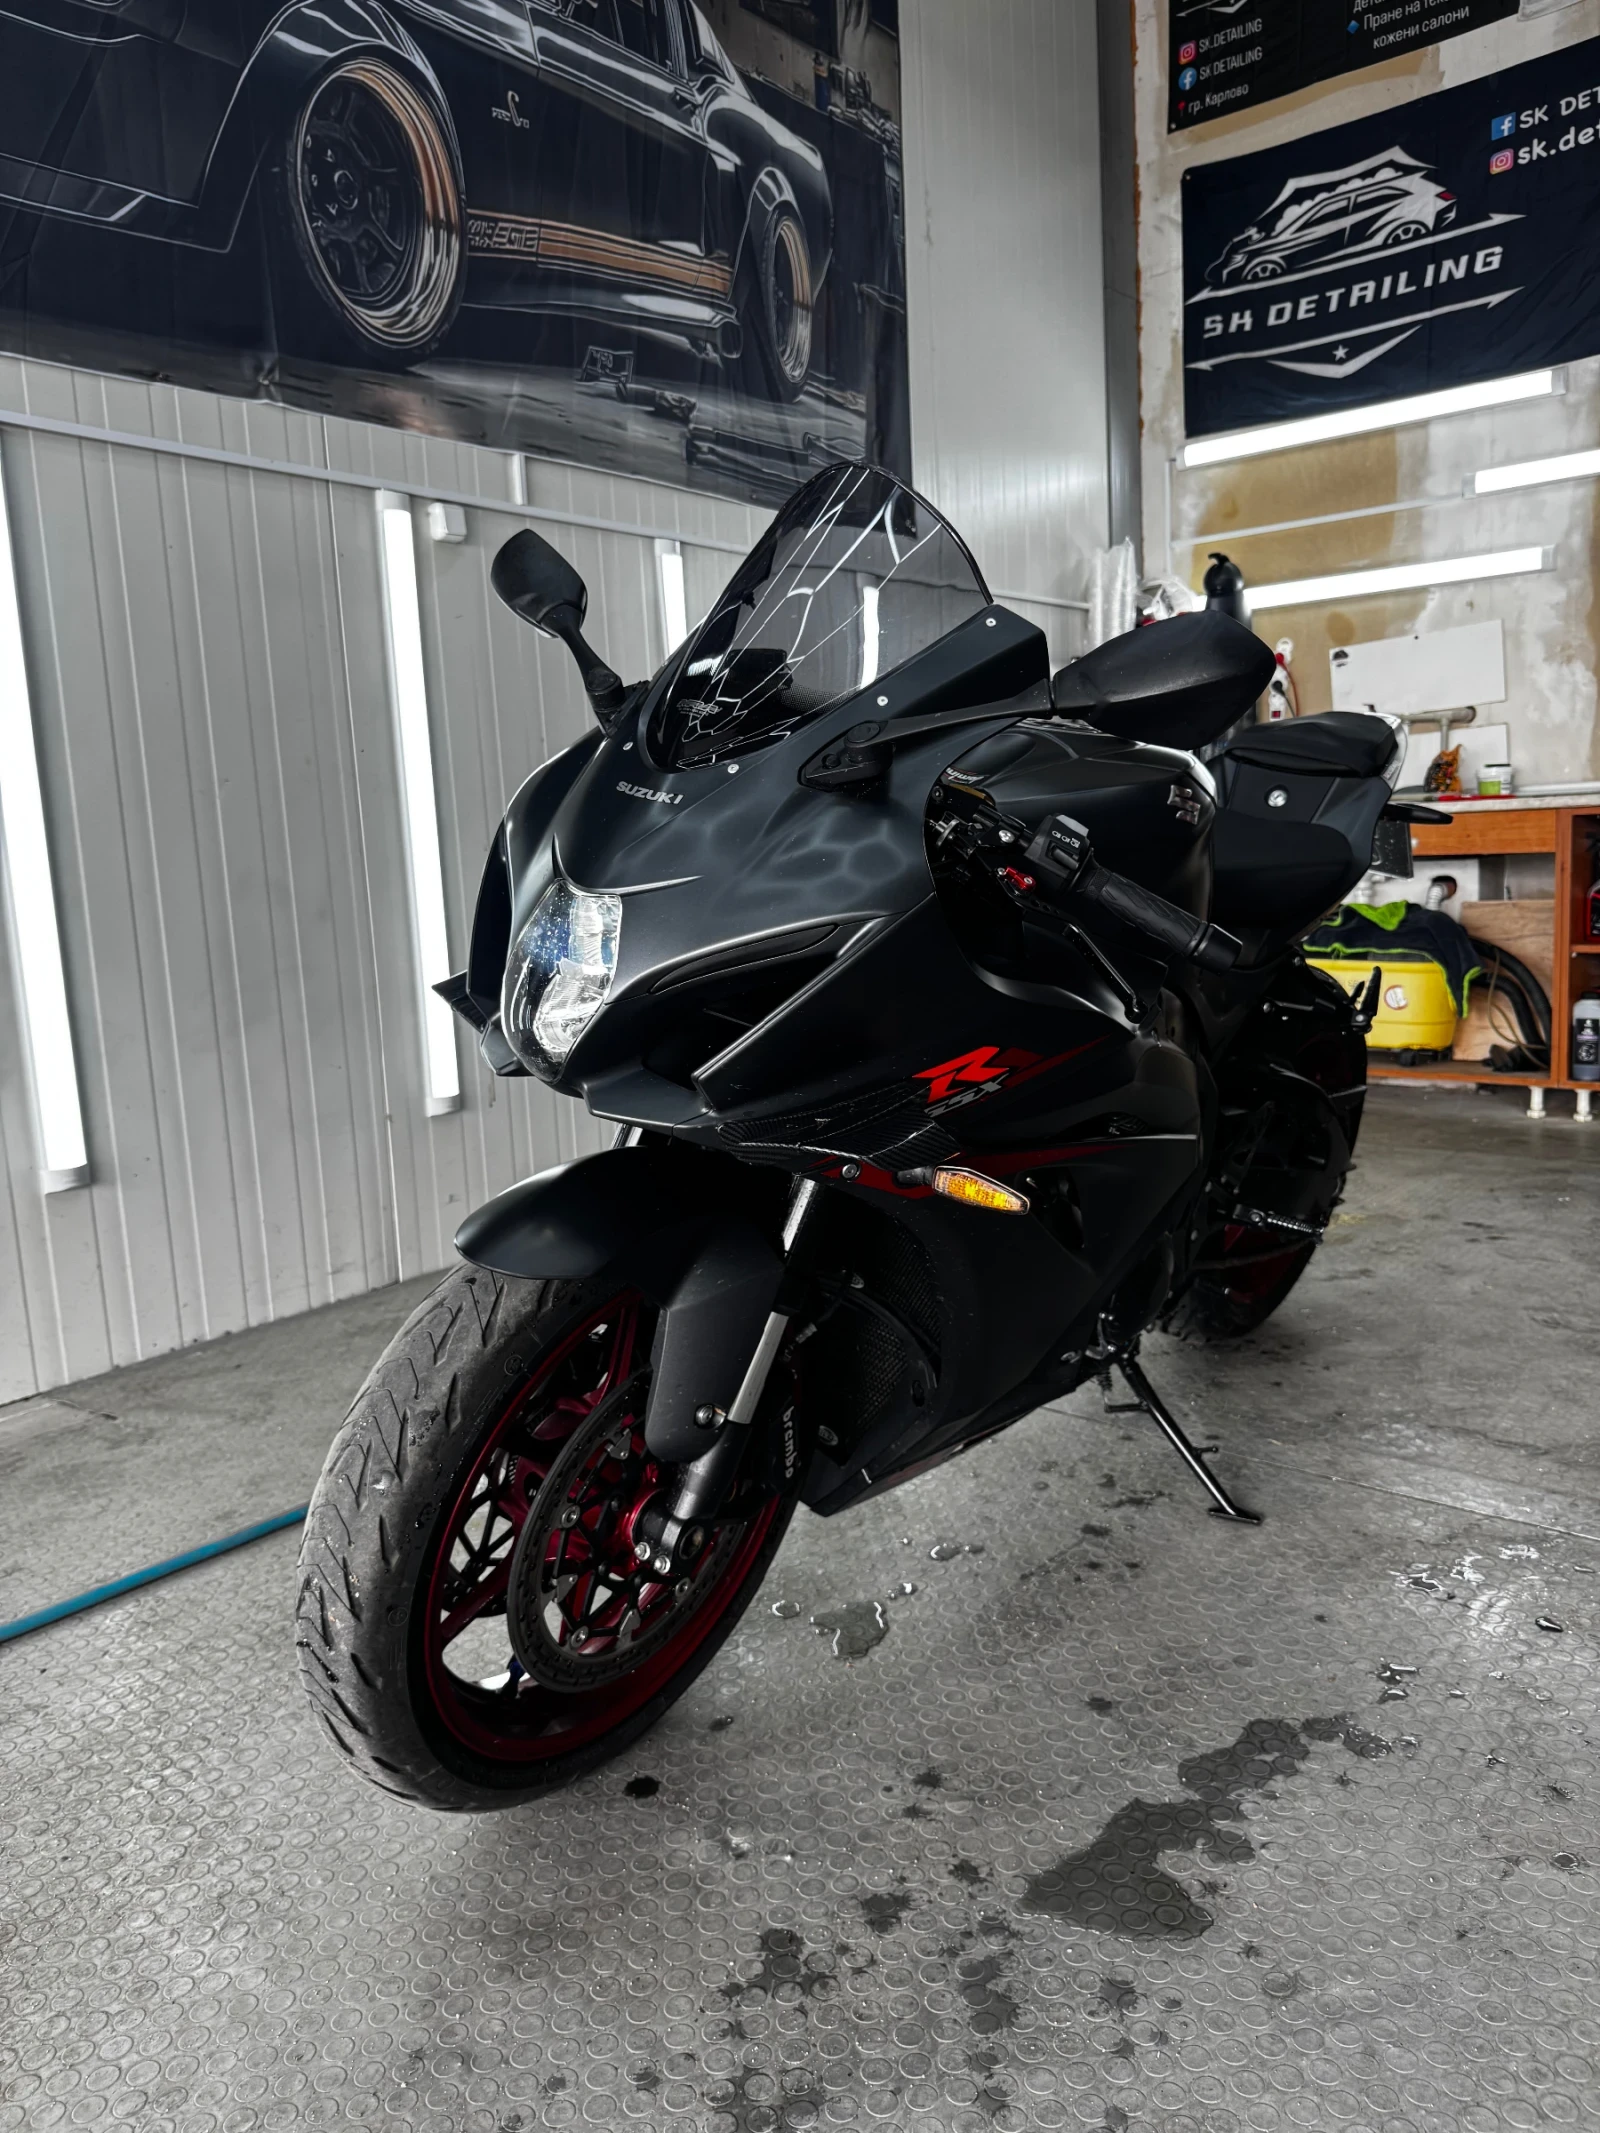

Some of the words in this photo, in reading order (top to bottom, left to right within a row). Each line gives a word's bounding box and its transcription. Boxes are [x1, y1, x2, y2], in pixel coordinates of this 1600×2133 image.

[1364, 7, 1403, 31] Пране
[1405, 2, 1421, 15] на
[1373, 24, 1420, 49] кожени
[1422, 6, 1470, 32] салони
[1199, 64, 1212, 80] SK
[1213, 46, 1263, 76] DETAILING
[1205, 84, 1249, 108] Карлово
[1519, 104, 1549, 128] SK
[1267, 246, 1503, 327] DETAILING
[616, 781, 684, 804] SUZUKI
